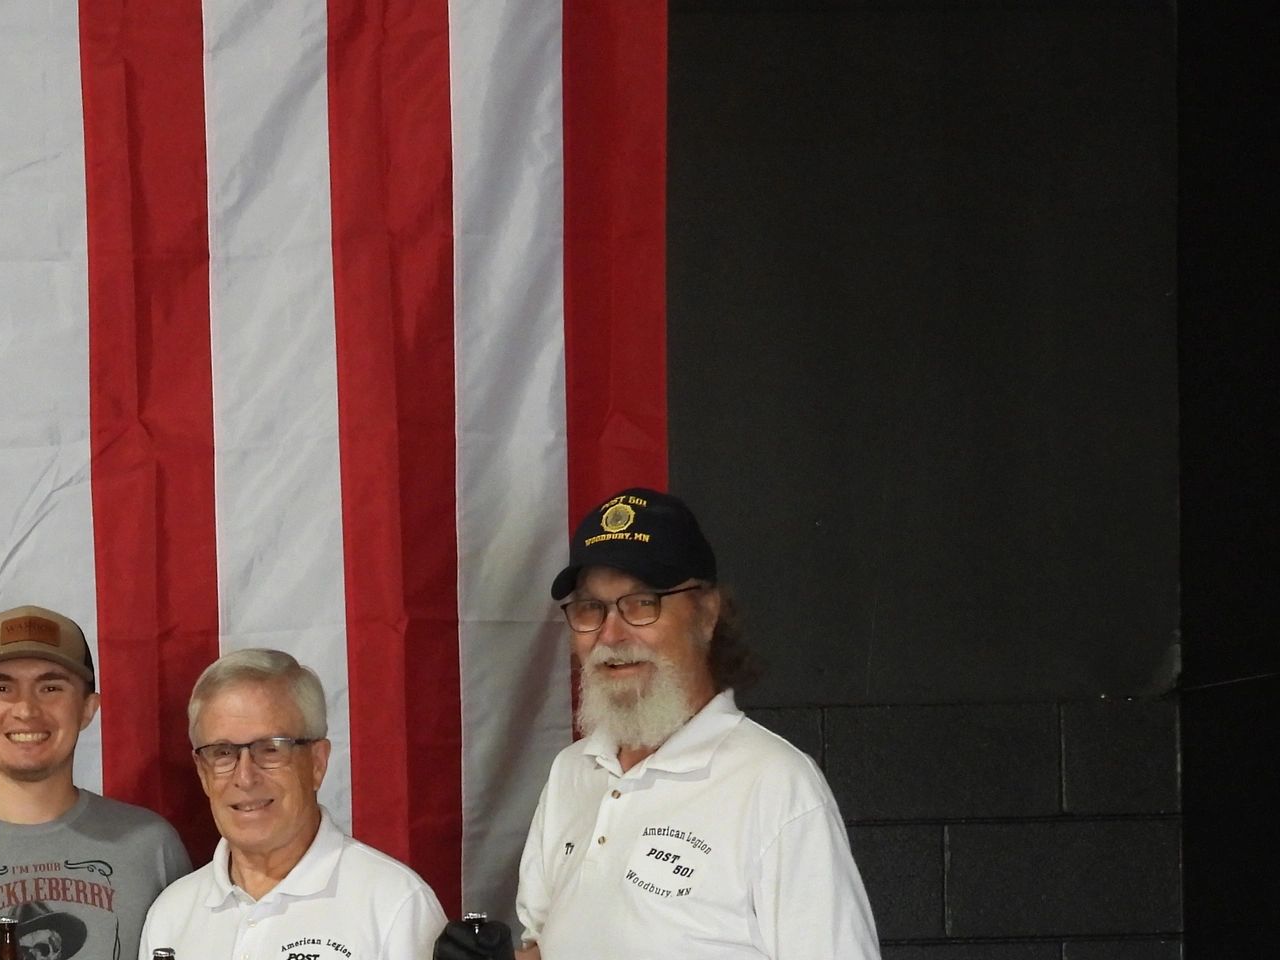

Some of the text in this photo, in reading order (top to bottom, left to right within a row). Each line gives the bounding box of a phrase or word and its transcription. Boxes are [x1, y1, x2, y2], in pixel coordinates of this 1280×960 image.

[628, 496, 647, 507] 501
[634, 533, 650, 542] MN
[642, 826, 712, 855] American Legion
[12, 862, 61, 874] I'M YOUR
[646, 848, 695, 878] POST 501
[676, 887, 692, 897] MN
[281, 938, 352, 958] American Legion
